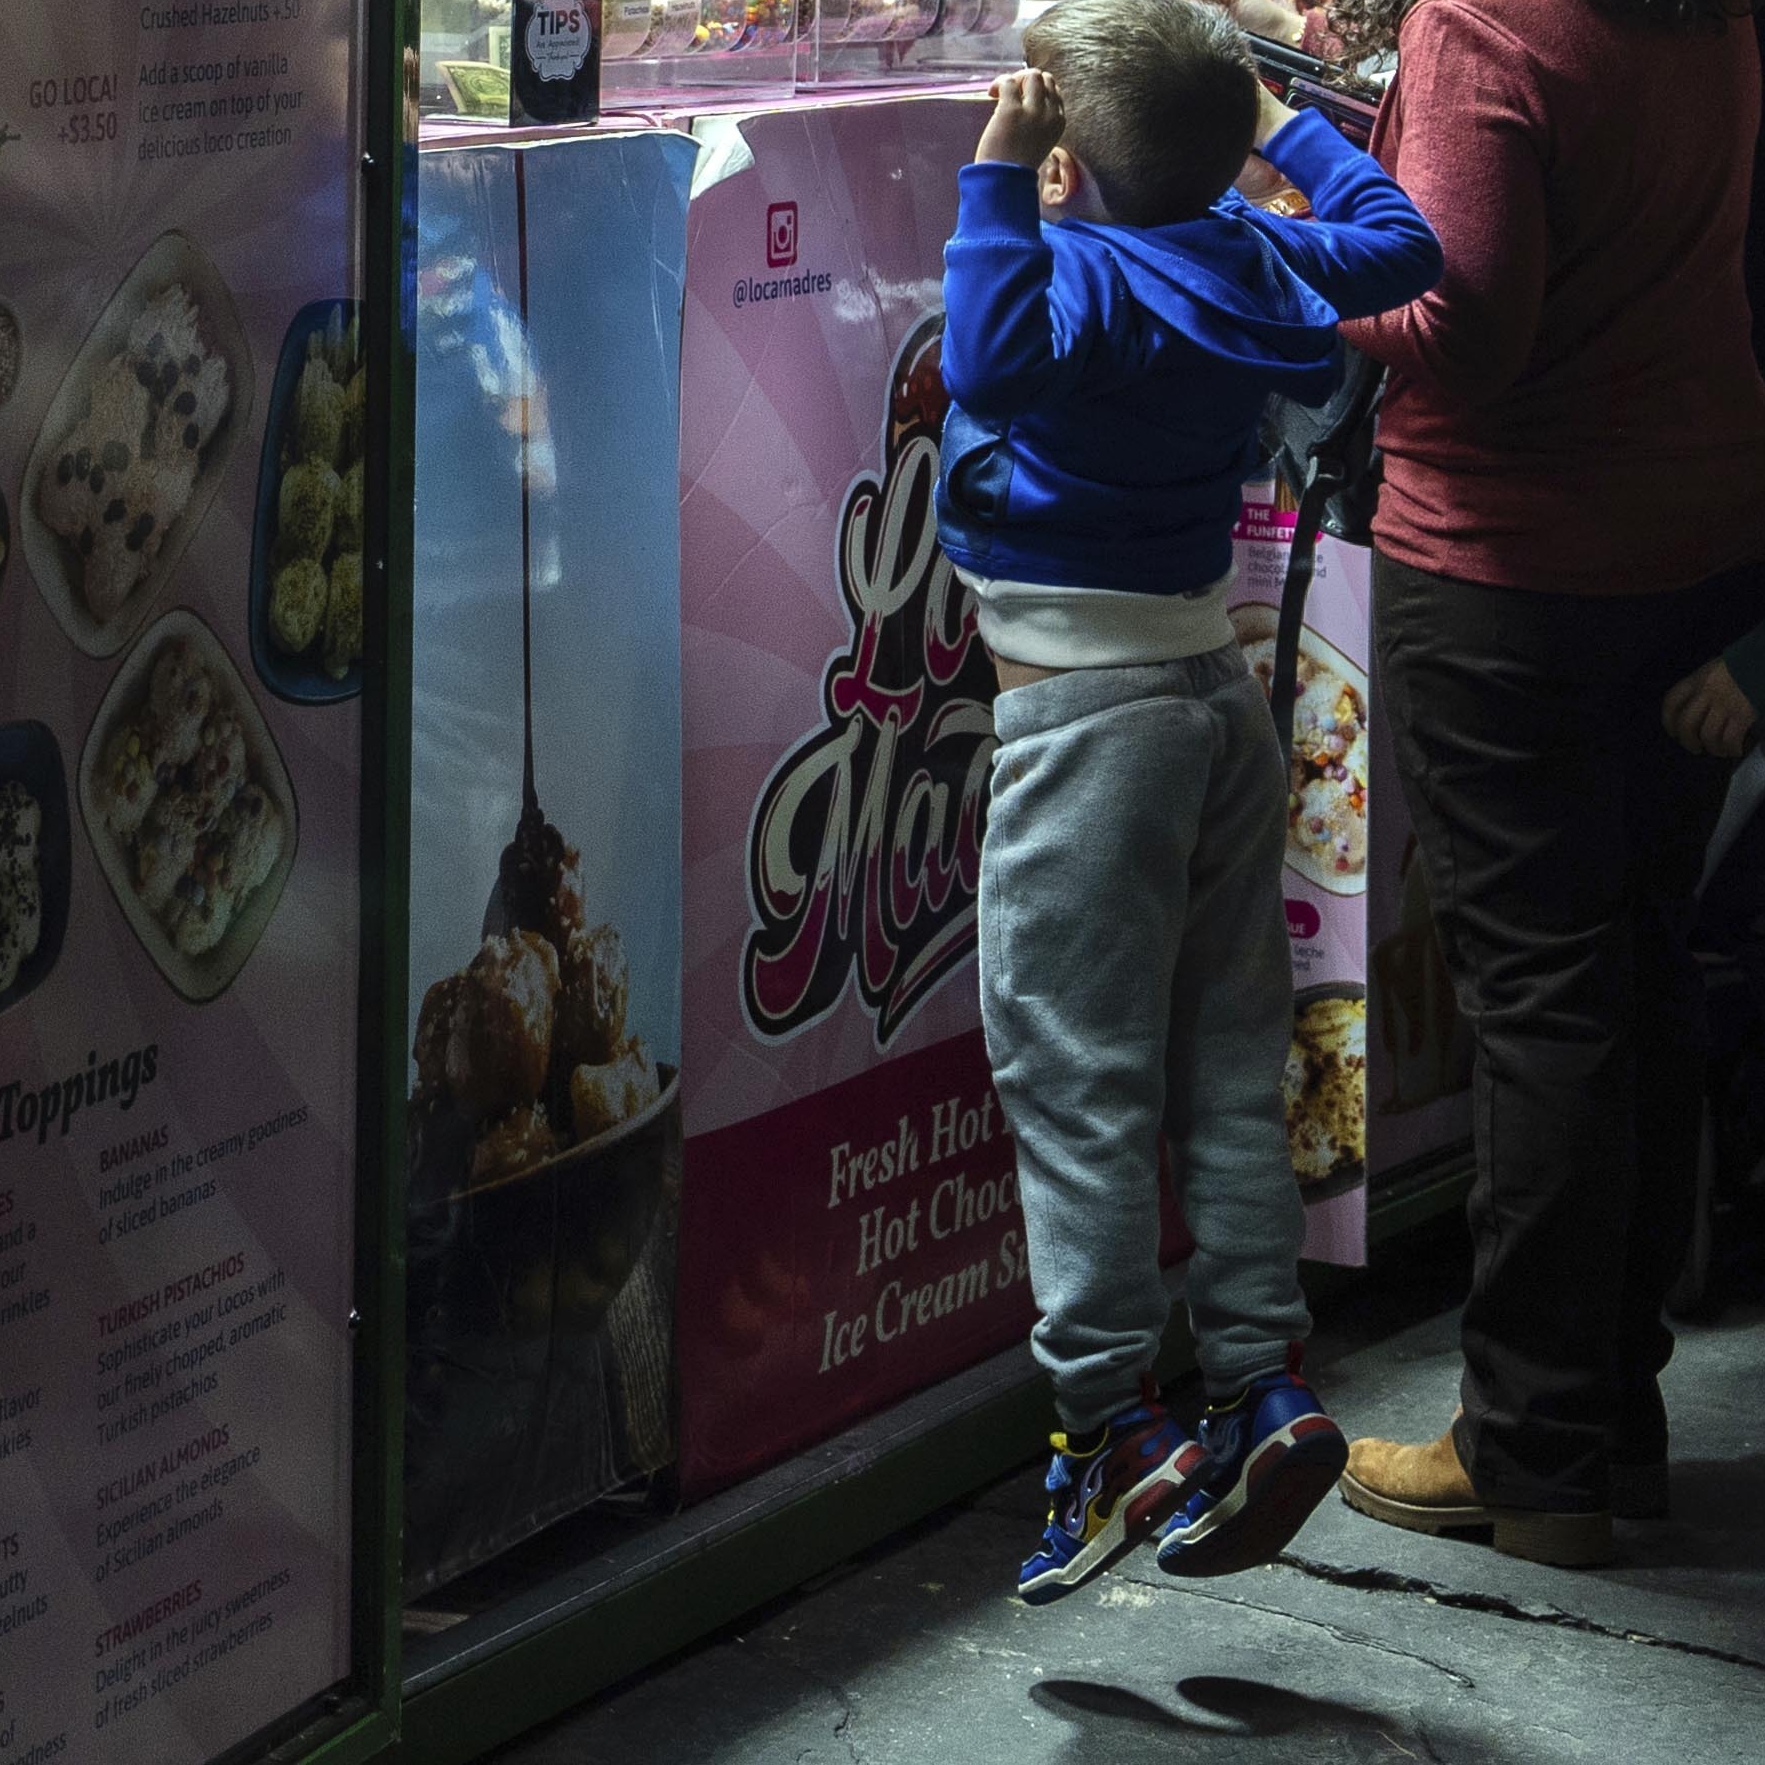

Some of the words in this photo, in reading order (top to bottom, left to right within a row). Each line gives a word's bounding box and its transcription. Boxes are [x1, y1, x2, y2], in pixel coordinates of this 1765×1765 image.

[537, 9, 582, 36] TIPS
[29, 78, 57, 109] GO
[63, 73, 119, 106] LOCA!
[57, 111, 119, 145] +$3.50
[733, 268, 832, 309] @locamadres
[1247, 506, 1271, 522] THE
[98, 1123, 170, 1175] BANANAS
[827, 1115, 919, 1209] Fresh
[928, 1090, 995, 1165] Hot
[856, 1197, 922, 1277] Hot
[98, 1290, 161, 1338] TURKISH
[163, 1250, 246, 1310] PISTACHIOS
[818, 1309, 868, 1375] Ice
[876, 1258, 989, 1343] Cream
[97, 1461, 157, 1511] SICILIAN
[158, 1423, 231, 1476] ALMONDS
[94, 1579, 203, 1659] STRAWBERRIES
